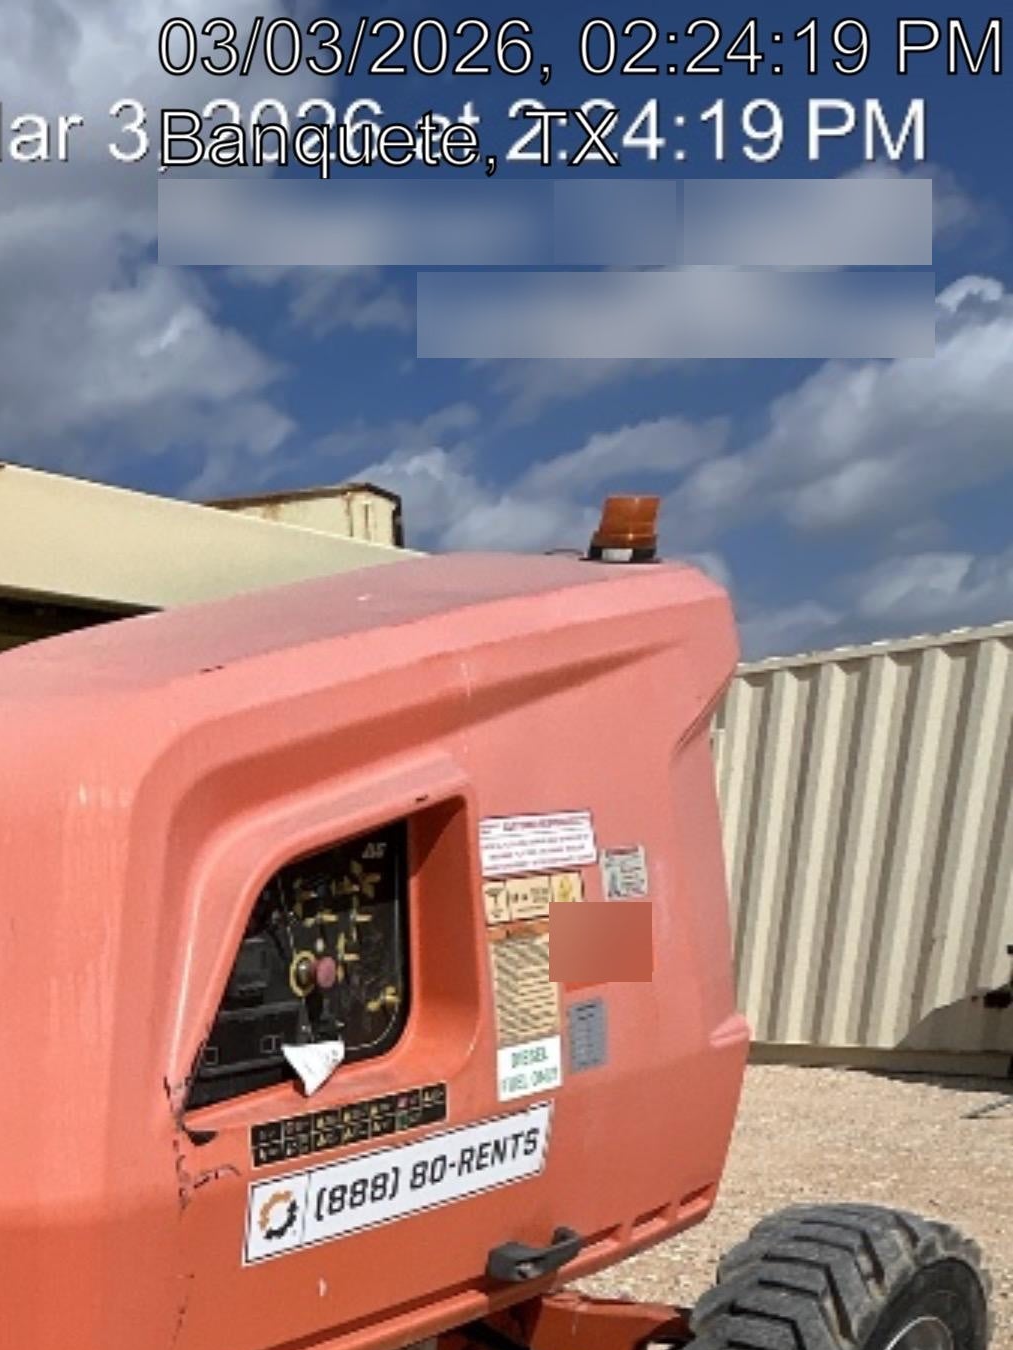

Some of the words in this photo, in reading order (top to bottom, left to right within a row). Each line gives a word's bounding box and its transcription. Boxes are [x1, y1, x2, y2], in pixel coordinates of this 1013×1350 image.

[511, 1046, 548, 1069] DIESEL
[315, 1165, 401, 1222] (888)
[409, 1126, 540, 1192] 80-RENTS
